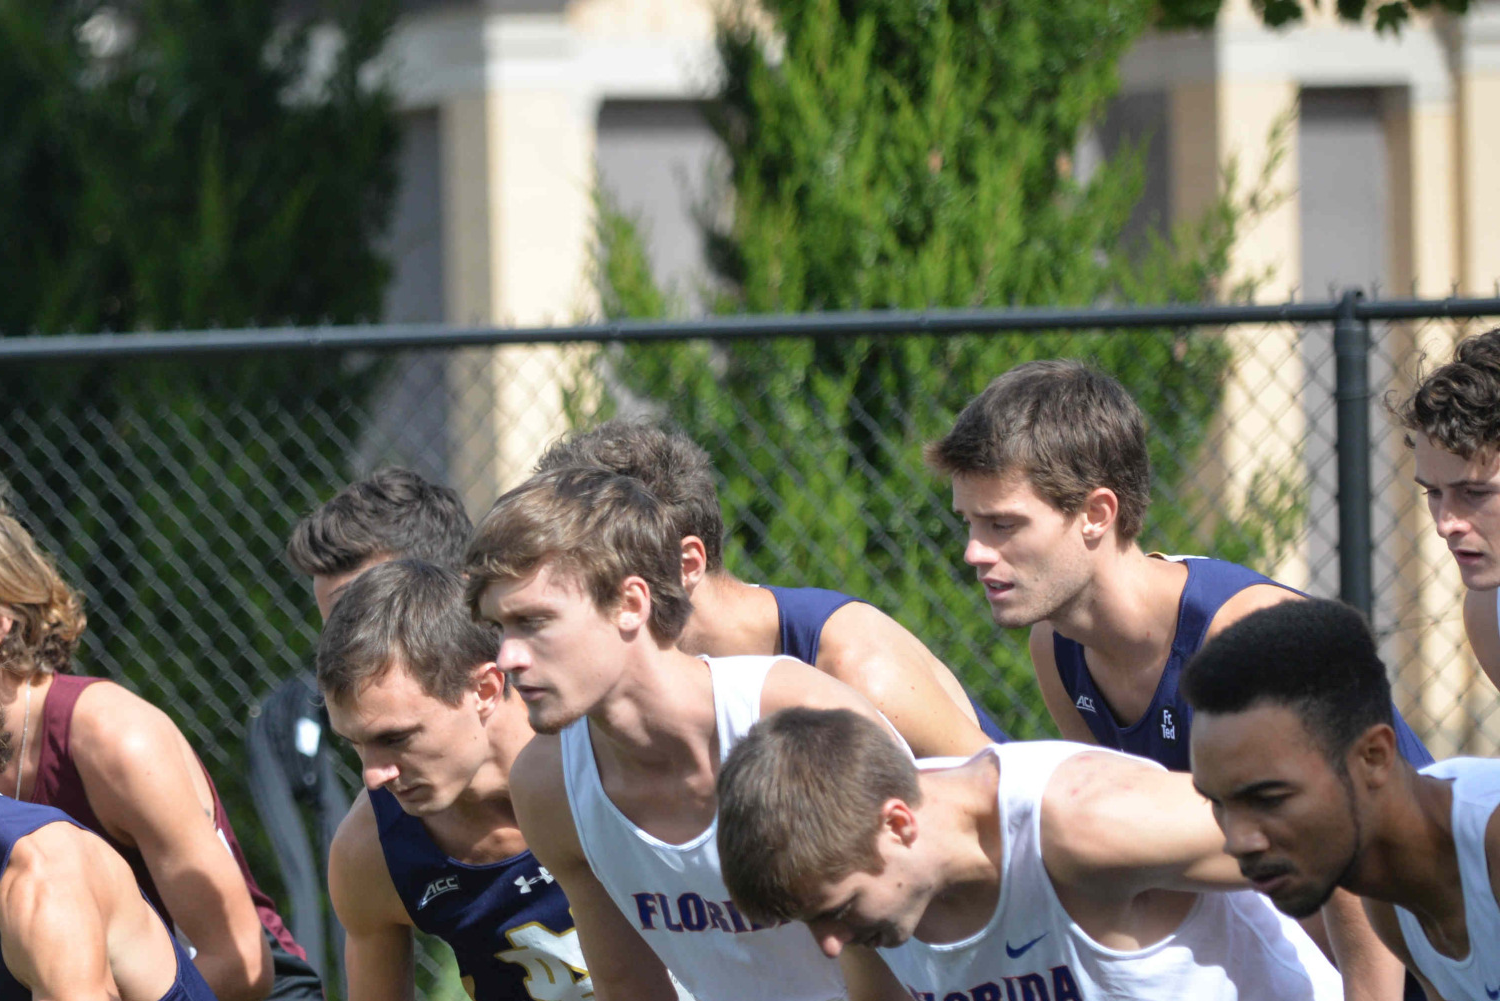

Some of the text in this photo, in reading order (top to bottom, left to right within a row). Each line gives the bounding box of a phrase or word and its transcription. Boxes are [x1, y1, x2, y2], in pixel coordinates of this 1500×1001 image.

[1161, 724, 1176, 740] Ted
[419, 875, 460, 909] ACC
[632, 891, 792, 934] FLORI
